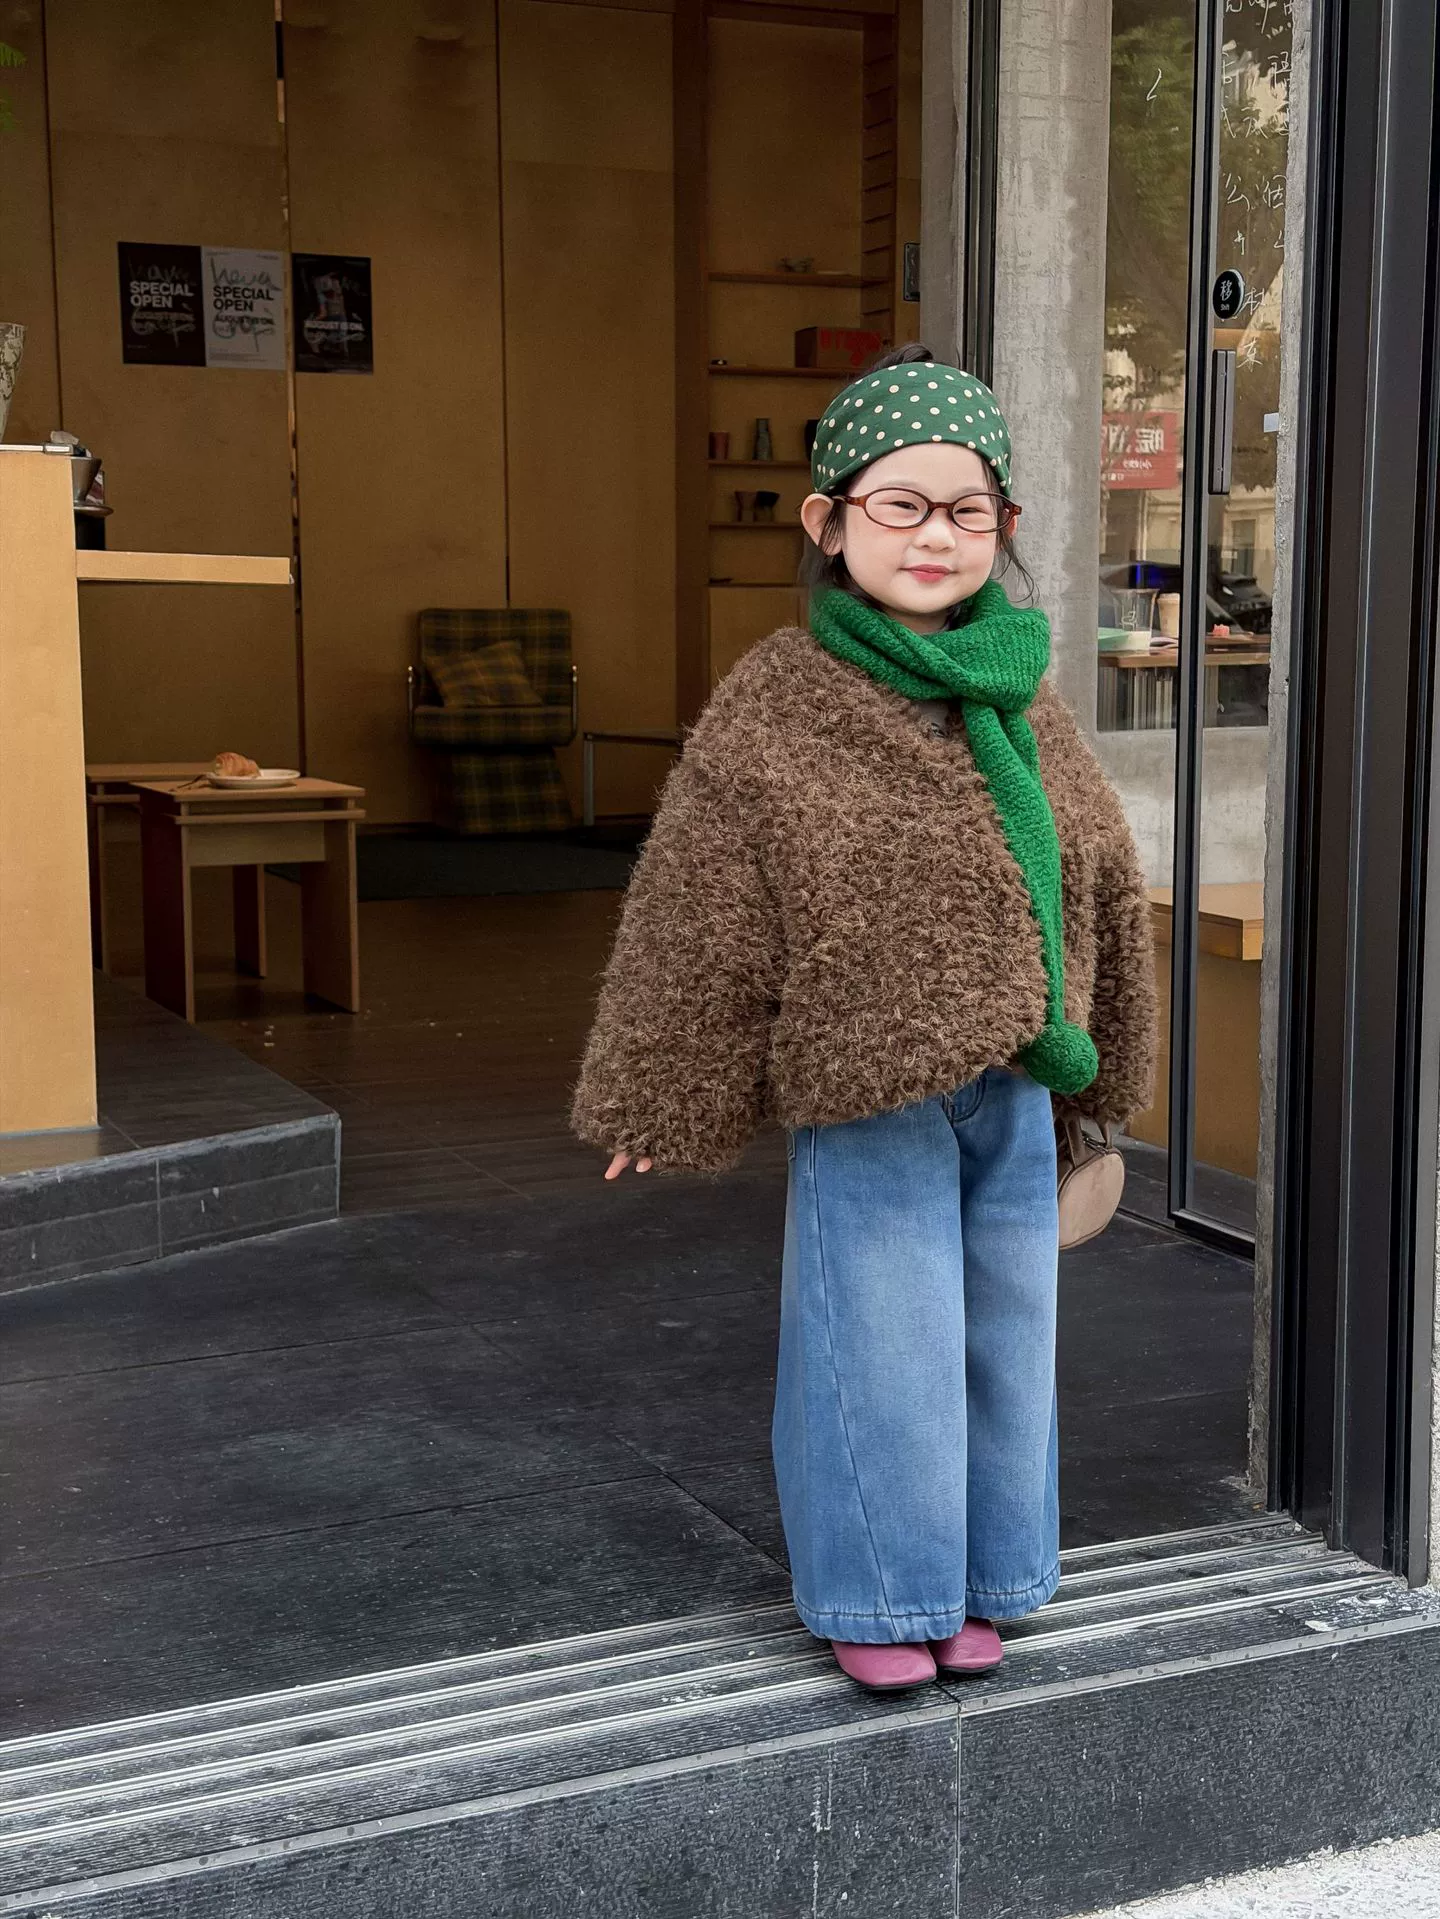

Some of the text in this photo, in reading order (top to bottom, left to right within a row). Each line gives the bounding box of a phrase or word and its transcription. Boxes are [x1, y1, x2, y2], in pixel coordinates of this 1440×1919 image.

[129, 280, 195, 297] SPECIAL
[213, 285, 275, 301] SPECIAL
[1220, 280, 1233, 301] 移
[129, 294, 174, 309] OPEN
[213, 298, 254, 312] OPEN
